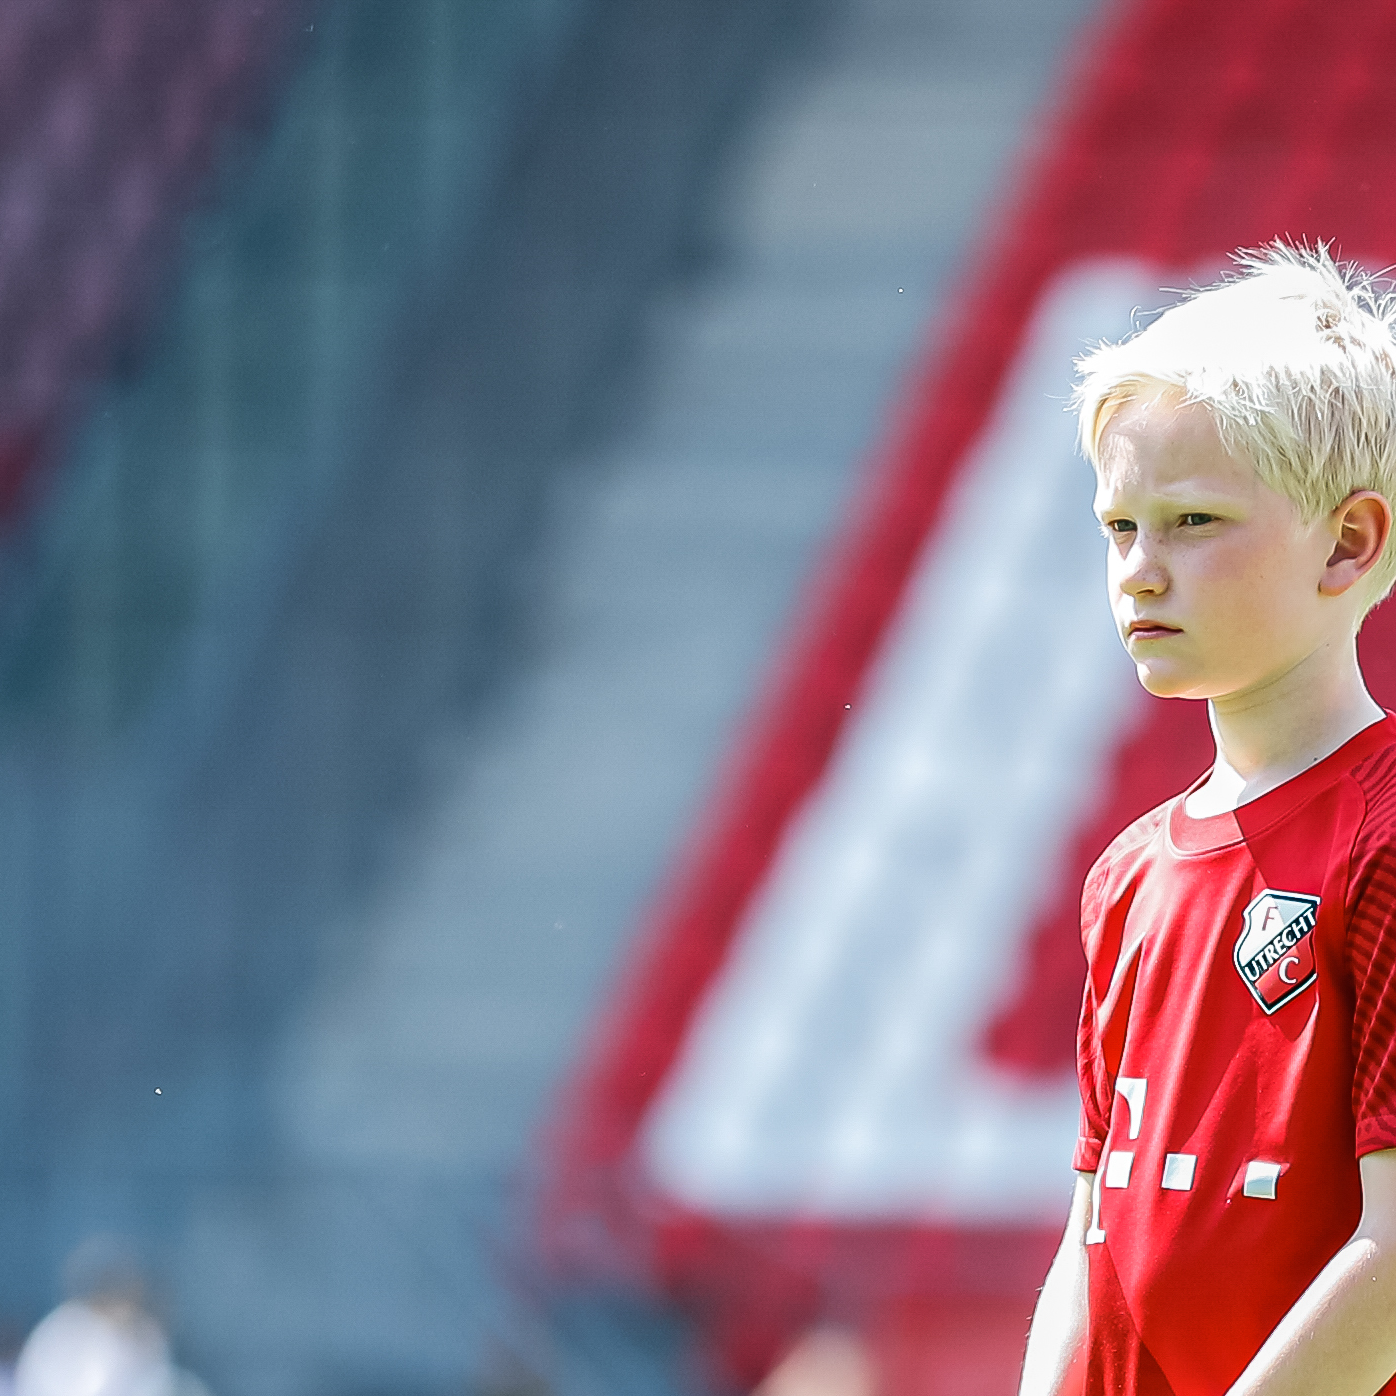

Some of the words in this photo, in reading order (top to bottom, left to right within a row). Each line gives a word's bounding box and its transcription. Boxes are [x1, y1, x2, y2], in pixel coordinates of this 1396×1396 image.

[1261, 906, 1278, 932] F
[1244, 907, 1316, 982] UTRECHT
[1278, 956, 1299, 985] C
